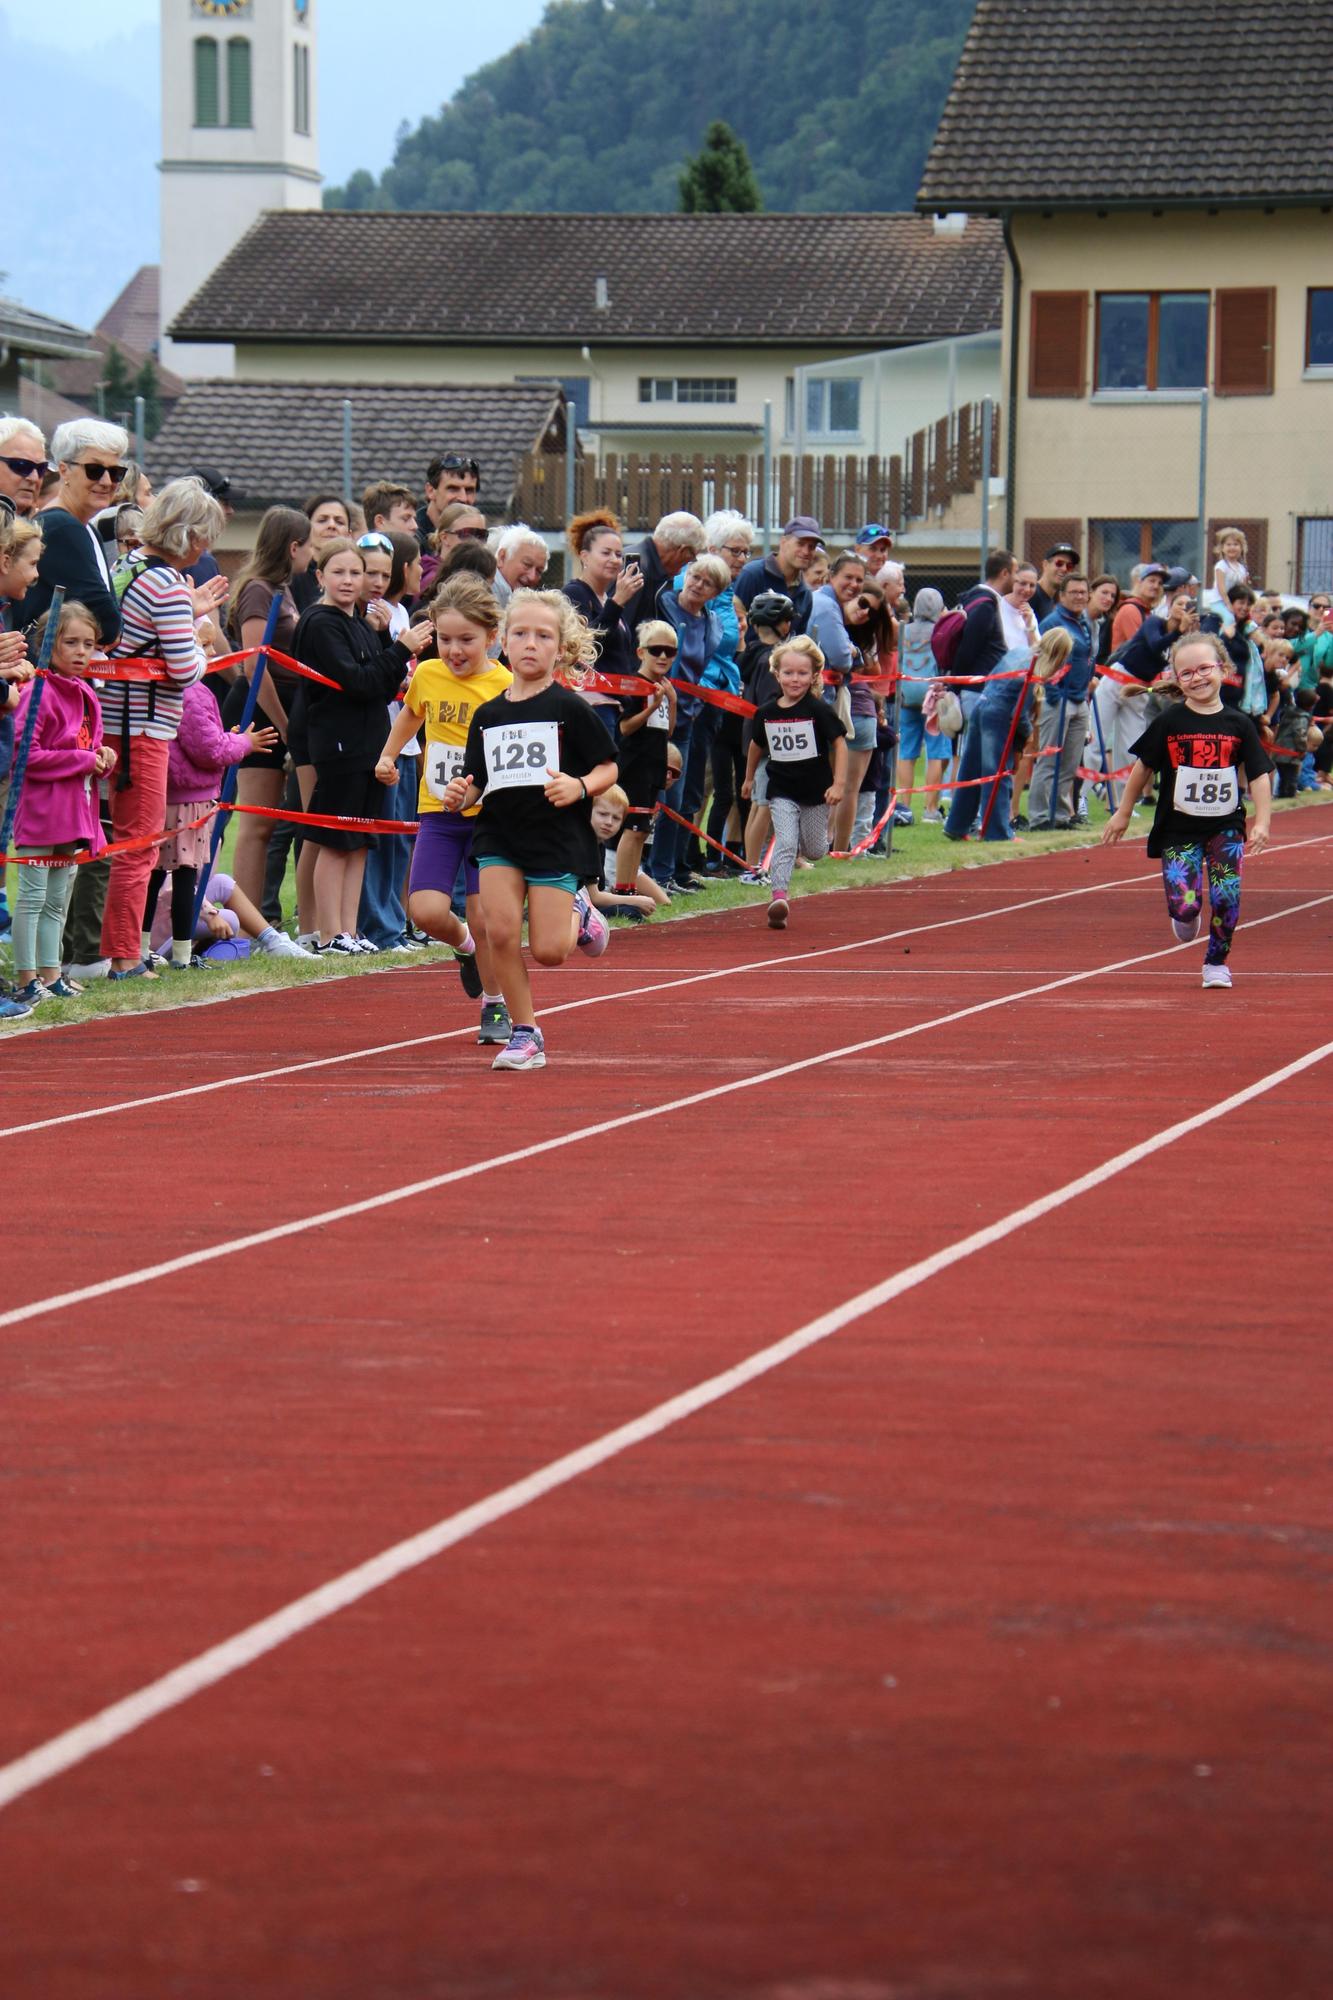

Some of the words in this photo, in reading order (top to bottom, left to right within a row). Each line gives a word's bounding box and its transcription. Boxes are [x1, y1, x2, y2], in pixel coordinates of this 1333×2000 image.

[772, 733, 808, 751] 205
[492, 741, 547, 772] 128
[1184, 782, 1232, 803] 185
